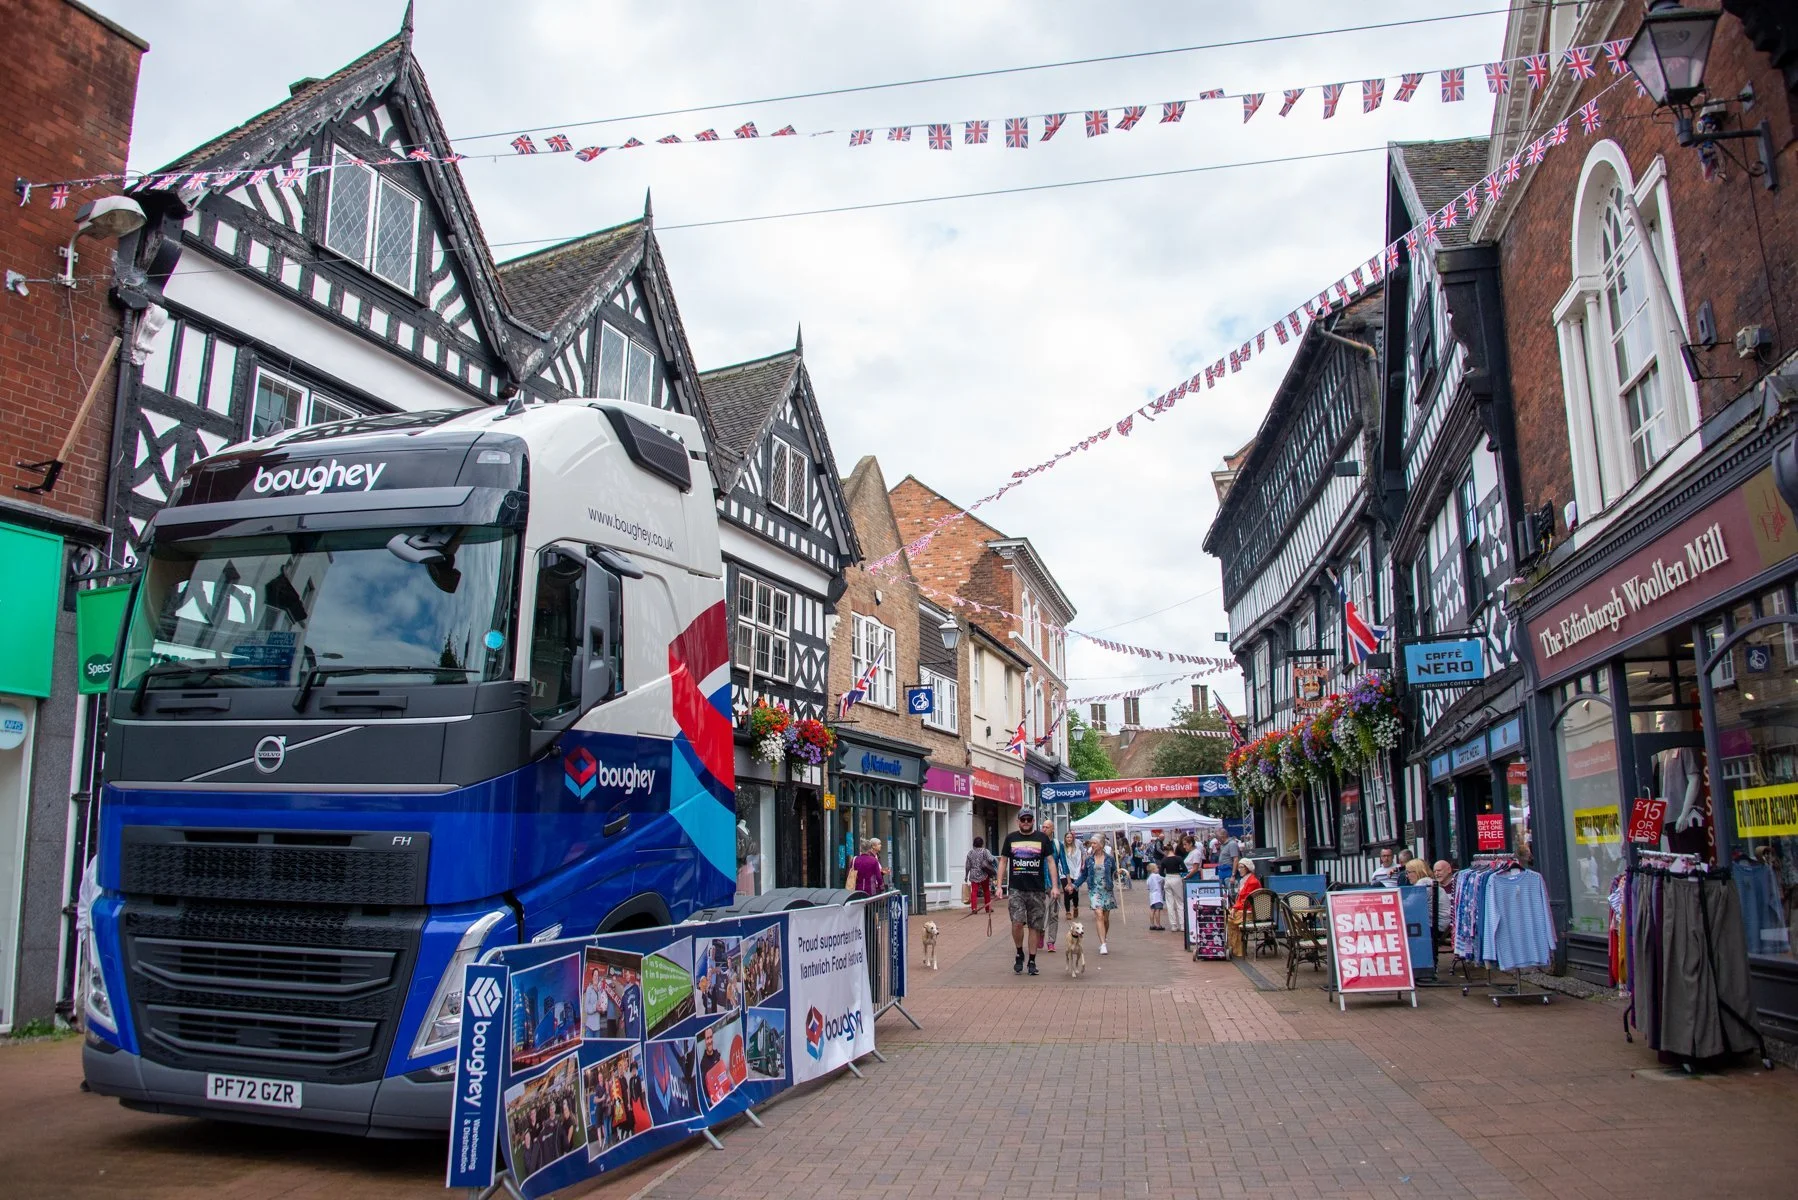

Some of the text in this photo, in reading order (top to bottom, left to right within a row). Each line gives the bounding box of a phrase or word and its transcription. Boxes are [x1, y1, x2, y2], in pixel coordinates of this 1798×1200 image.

[253, 459, 387, 496] boughey
[588, 507, 674, 552] www.boughey.co.uk
[1539, 522, 1730, 659] The Edinburgh Woollen Mill
[1425, 649, 1462, 661] CAFFÈ
[1299, 668, 1323, 677] CROWN
[1417, 661, 1474, 676] NERO
[1301, 701, 1323, 709] HOTEL
[5, 719, 23, 730] NHS
[599, 760, 656, 795] boughey
[1056, 788, 1086, 798] boughey
[1095, 783, 1193, 795] Welcome to the Festival
[1635, 801, 1663, 820] £15
[1737, 798, 1770, 828] FURTHER
[1478, 830, 1505, 839] FREE
[1636, 820, 1654, 830] OR
[391, 836, 412, 846] FH
[1628, 829, 1658, 841] LESS
[1012, 859, 1041, 868] Polaroid
[1191, 887, 1216, 895] NERO
[1335, 911, 1398, 933] SALE
[798, 934, 819, 953] Proud
[1339, 933, 1402, 955] SALE
[831, 953, 848, 972] Food
[1341, 956, 1404, 978] SALE
[627, 1000, 639, 1023] 24
[464, 1021, 492, 1107] boughey
[214, 1077, 295, 1104] PF72 GZR
[460, 1125, 470, 1174] Distribution
[468, 1118, 481, 1171] Warehousing
